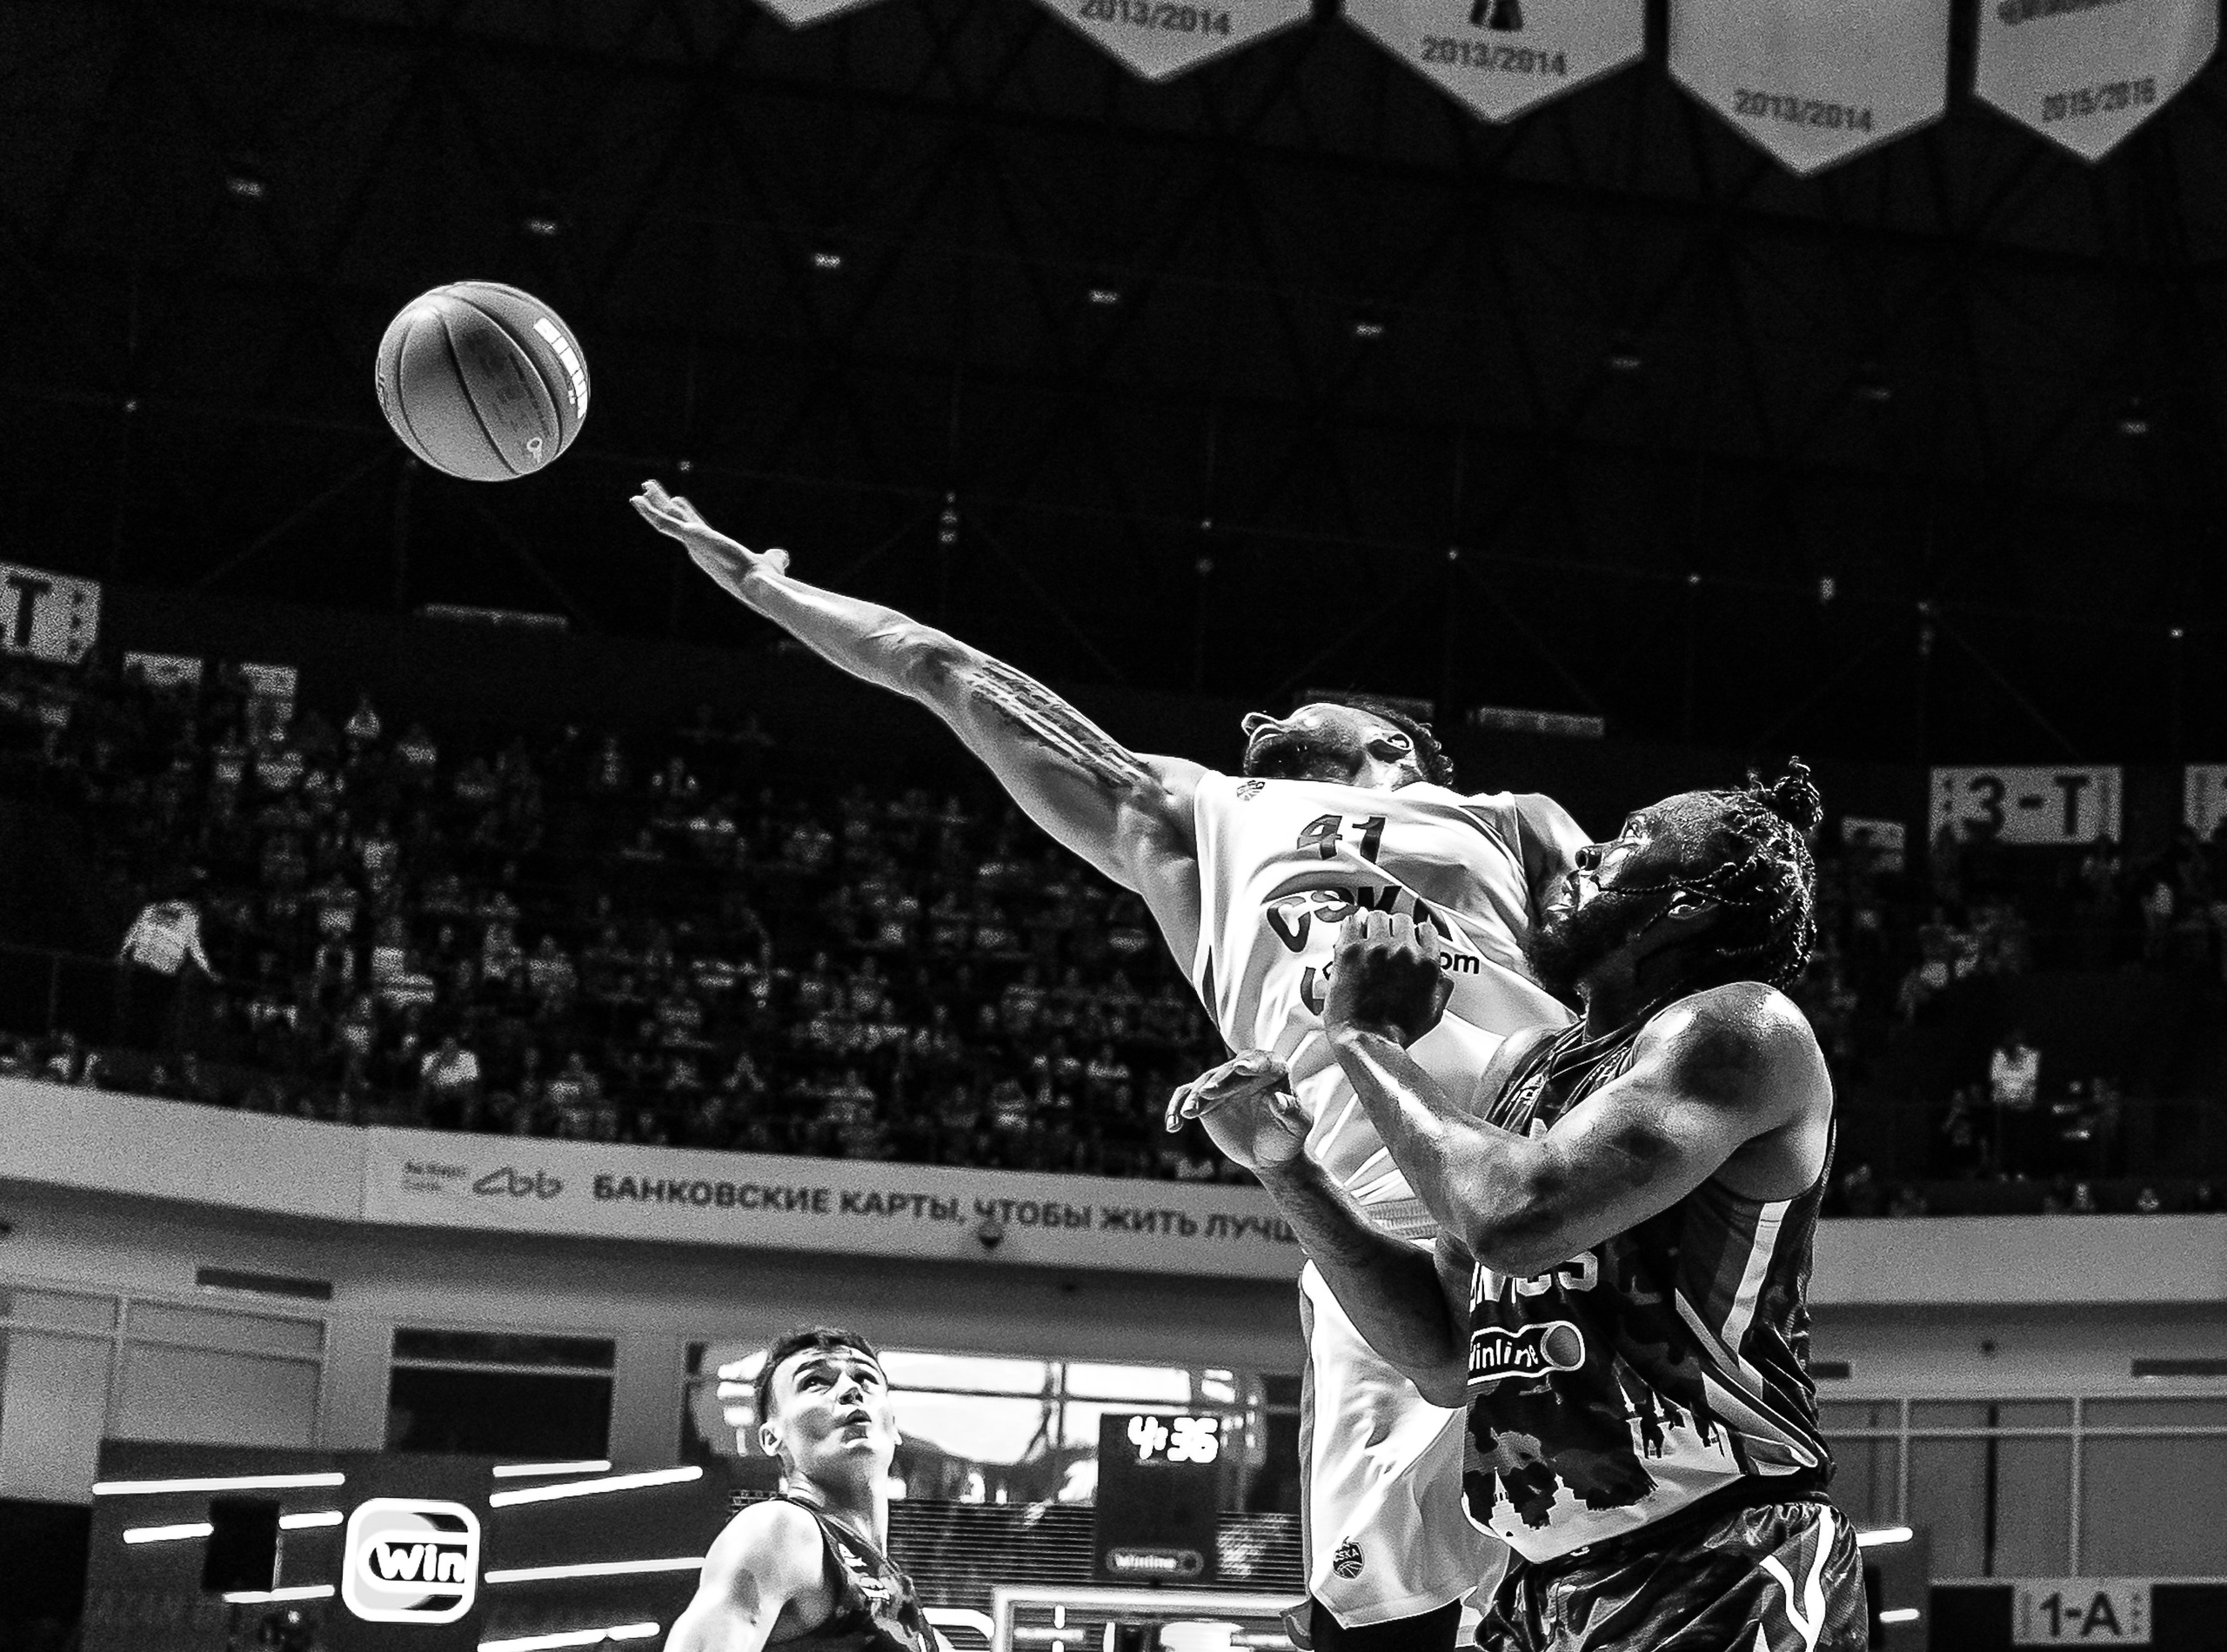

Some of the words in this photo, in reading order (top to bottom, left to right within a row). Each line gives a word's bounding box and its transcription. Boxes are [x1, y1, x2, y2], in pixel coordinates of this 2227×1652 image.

[1420, 35, 1567, 76] 2013/2014
[1734, 89, 1873, 131] 2013/2014
[1296, 814, 1387, 864] 41
[592, 1174, 829, 1214] БАНКОВСКИЕ
[839, 1190, 965, 1226] КАРТЫ,
[973, 1198, 1092, 1228] ЧТОБЫ
[1100, 1206, 1197, 1237] ЖИТЬ
[2038, 1591, 2122, 1637] 1-A
